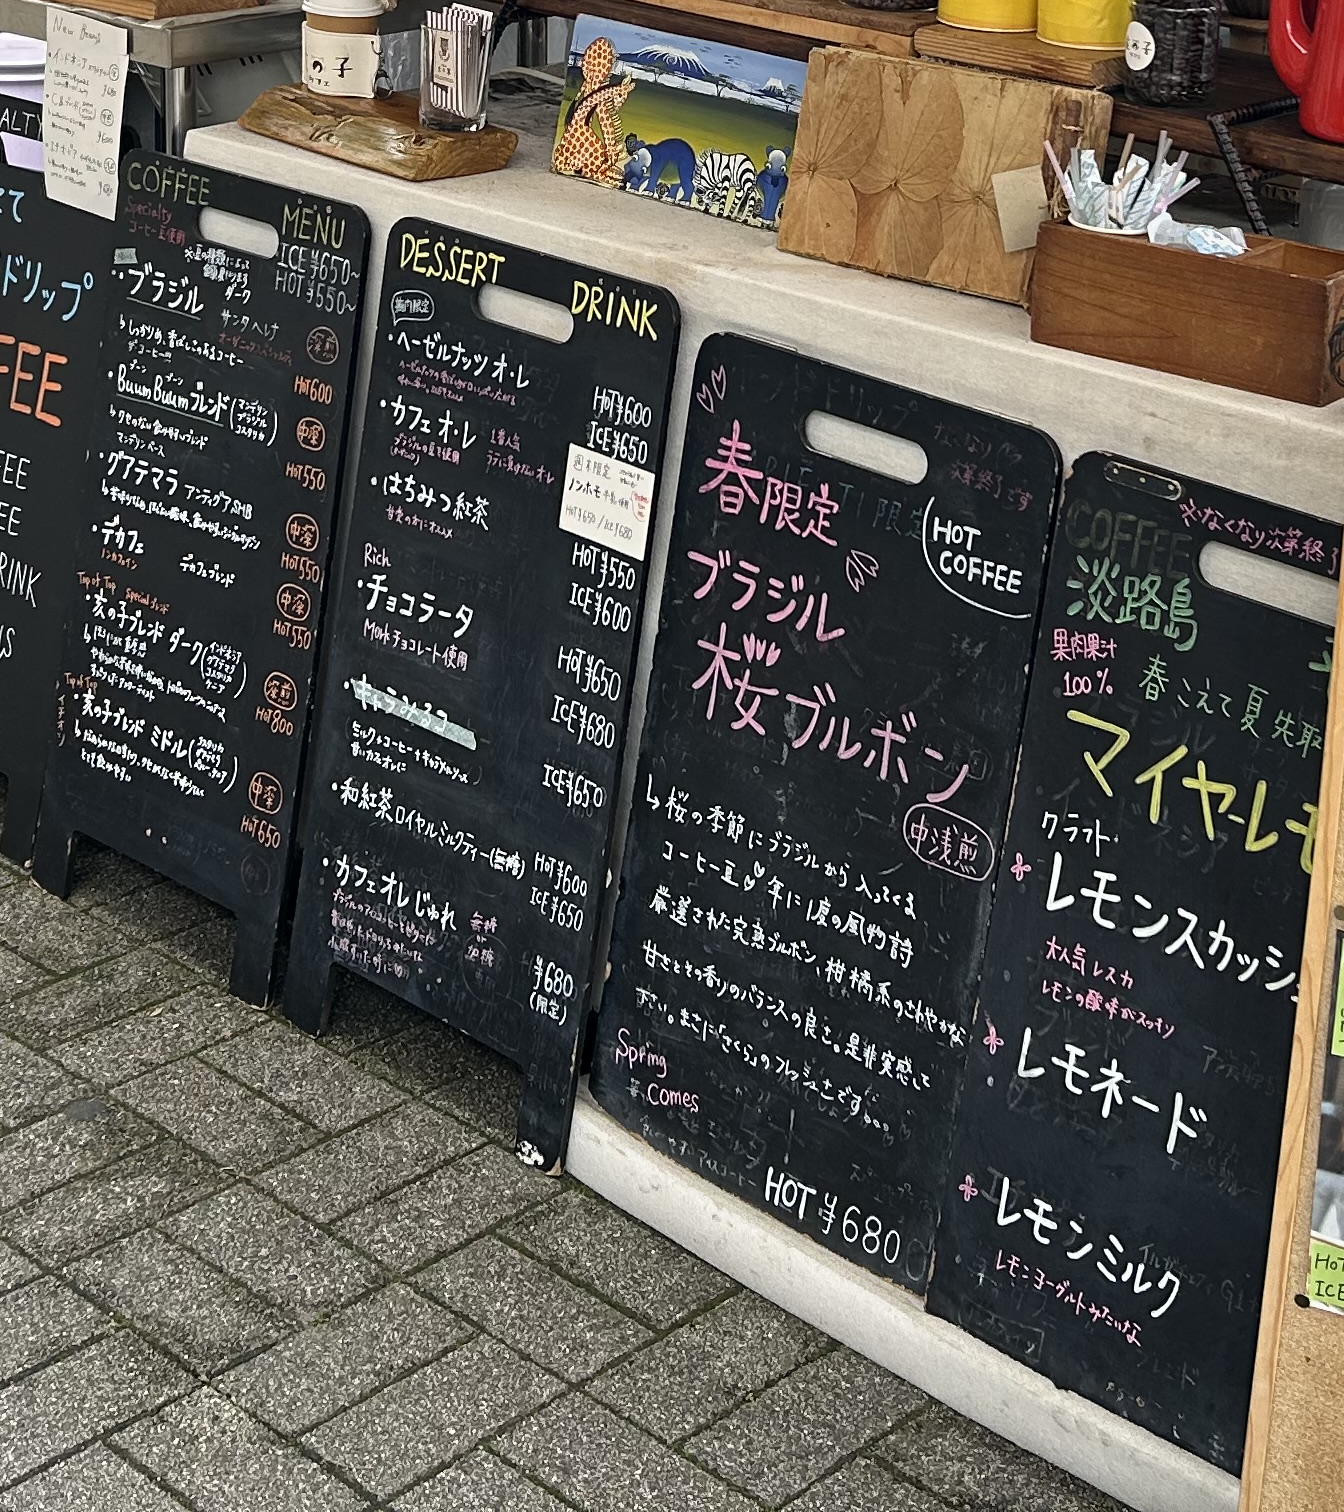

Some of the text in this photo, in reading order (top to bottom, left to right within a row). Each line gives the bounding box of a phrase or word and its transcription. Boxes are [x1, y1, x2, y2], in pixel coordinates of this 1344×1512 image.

[126, 161, 211, 206] COFFEE
[281, 202, 347, 249] MENU
[277, 241, 308, 273] ICE
[128, 261, 205, 314] ブラジル
[224, 283, 252, 305] ダーク
[274, 270, 306, 298] HOT
[399, 232, 659, 341] DESSERT DRINK
[383, 471, 490, 531] はちみつ紅茶
[698, 418, 840, 548] 春限定
[364, 542, 391, 568] Rich
[932, 515, 982, 551] HOT
[687, 548, 846, 642] ブラジル
[939, 550, 1024, 595] COFFEE
[365, 574, 474, 639] チョコラータ
[1065, 553, 1198, 652] 淡路島
[1050, 627, 1118, 662] 果肉果汁
[1062, 668, 1114, 697] 100%
[691, 621, 970, 803] 桜ブルボン
[1041, 811, 1111, 857] クラフト
[1045, 851, 1299, 1003] レモンスカッシ
[615, 1027, 668, 1078] Spring
[1017, 1026, 1208, 1155] レモネード
[764, 1165, 902, 1264] HOT ¥680
[996, 1176, 1182, 1318] レモンミルク
